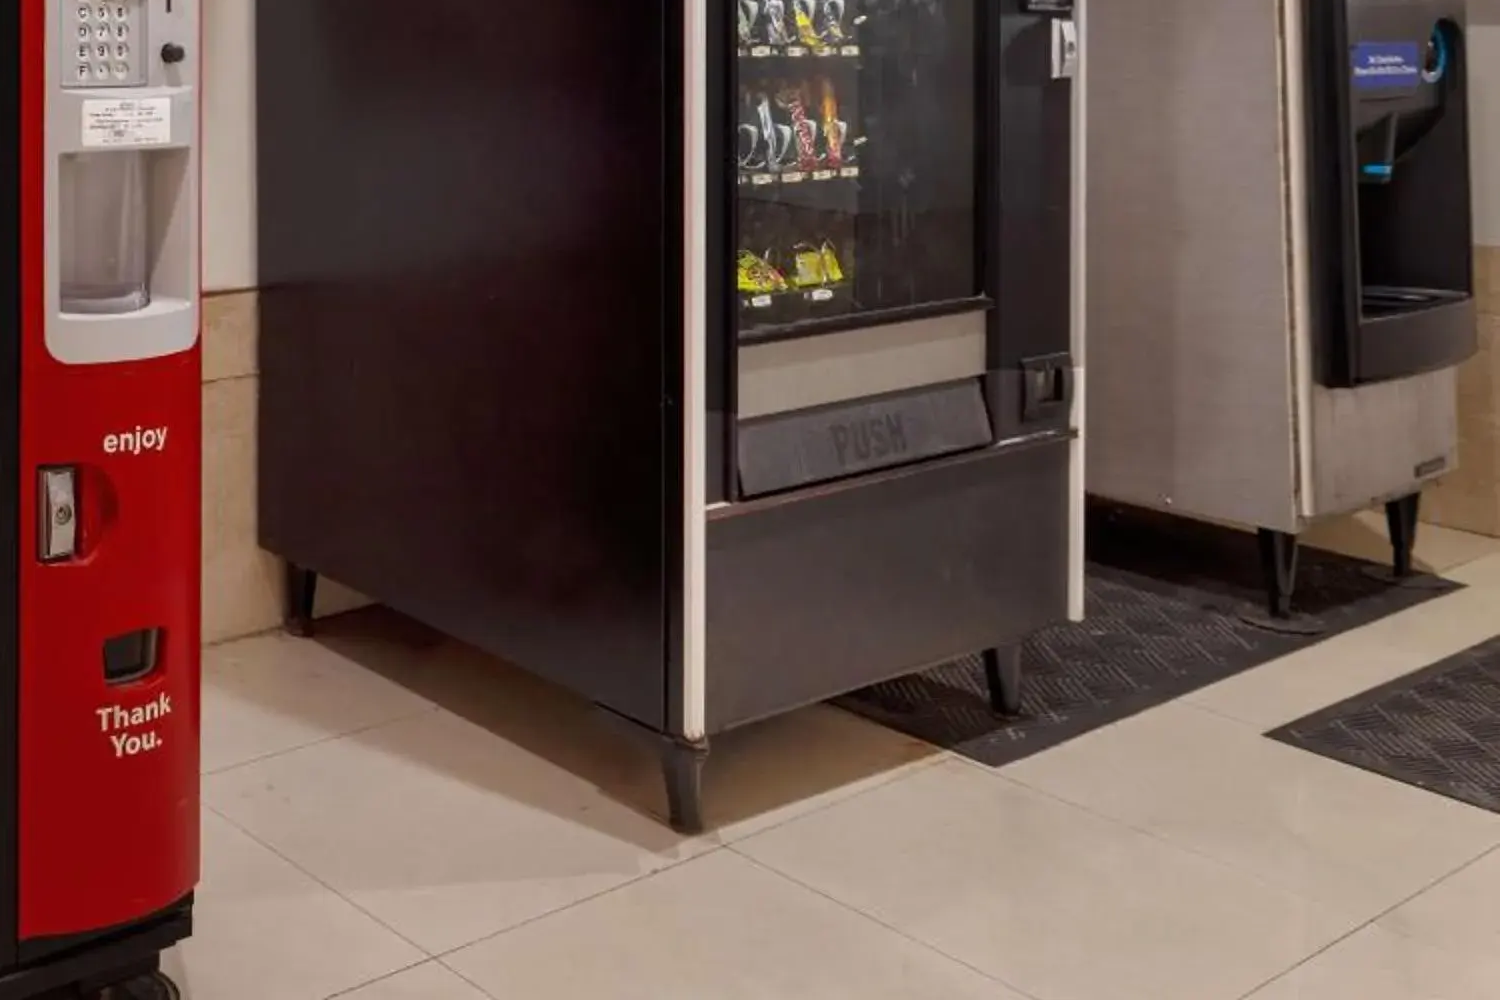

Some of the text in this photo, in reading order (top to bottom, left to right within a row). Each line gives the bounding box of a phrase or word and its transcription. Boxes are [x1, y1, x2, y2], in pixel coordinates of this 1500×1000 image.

[78, 66, 87, 76] F
[103, 425, 169, 455] enjoy
[828, 413, 908, 466] PUSH
[95, 691, 172, 733] Thank
[110, 730, 163, 759] You.
